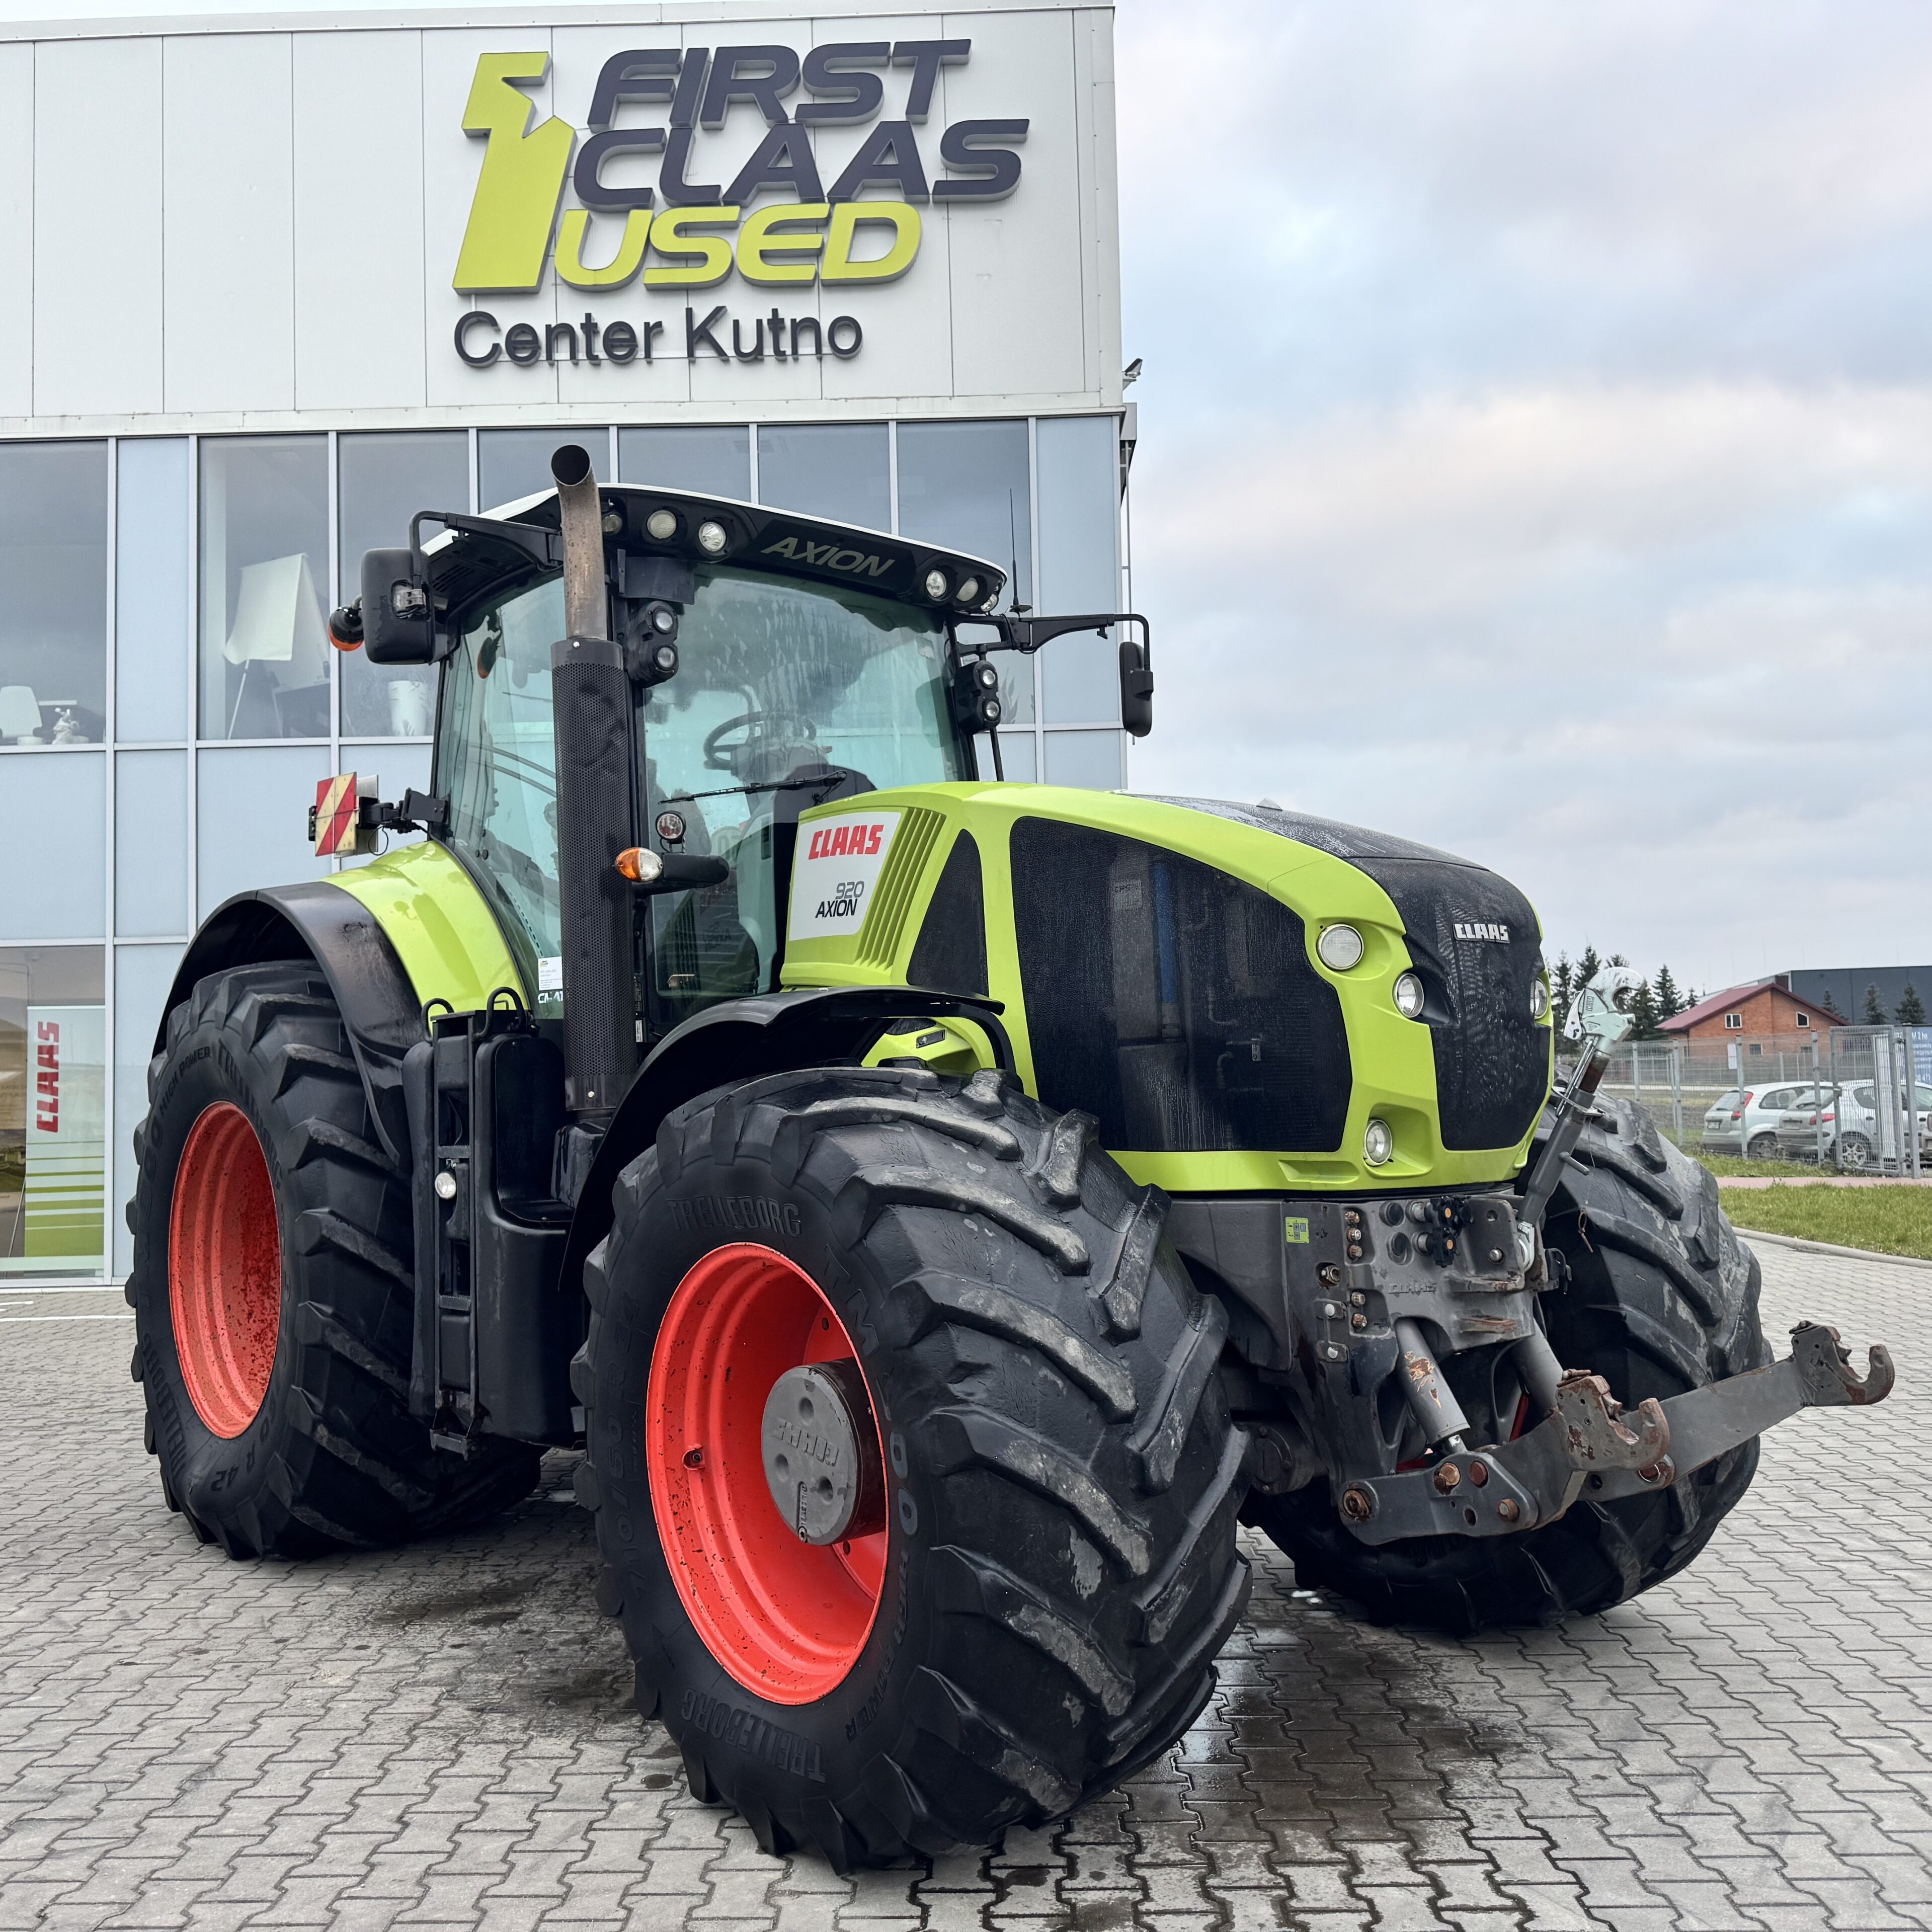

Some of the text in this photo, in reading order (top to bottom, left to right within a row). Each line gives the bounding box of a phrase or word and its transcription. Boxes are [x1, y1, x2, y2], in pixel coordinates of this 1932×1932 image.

[587, 39, 972, 133] FIRST
[573, 119, 1030, 212] CLAAS
[554, 201, 923, 292] USED
[454, 306, 863, 368] Center Kutno
[761, 536, 896, 577] AXION
[809, 824, 884, 860] CLAAS
[815, 899, 858, 919] AXION
[835, 880, 865, 900] 920
[1454, 923, 1509, 942] CLAAS
[37, 1021, 59, 1133] CLAAS
[159, 1046, 211, 1116] HIGH POWER
[665, 1194, 802, 1238] TRELLEBORG
[681, 1687, 826, 1784] TRELLEBORG
